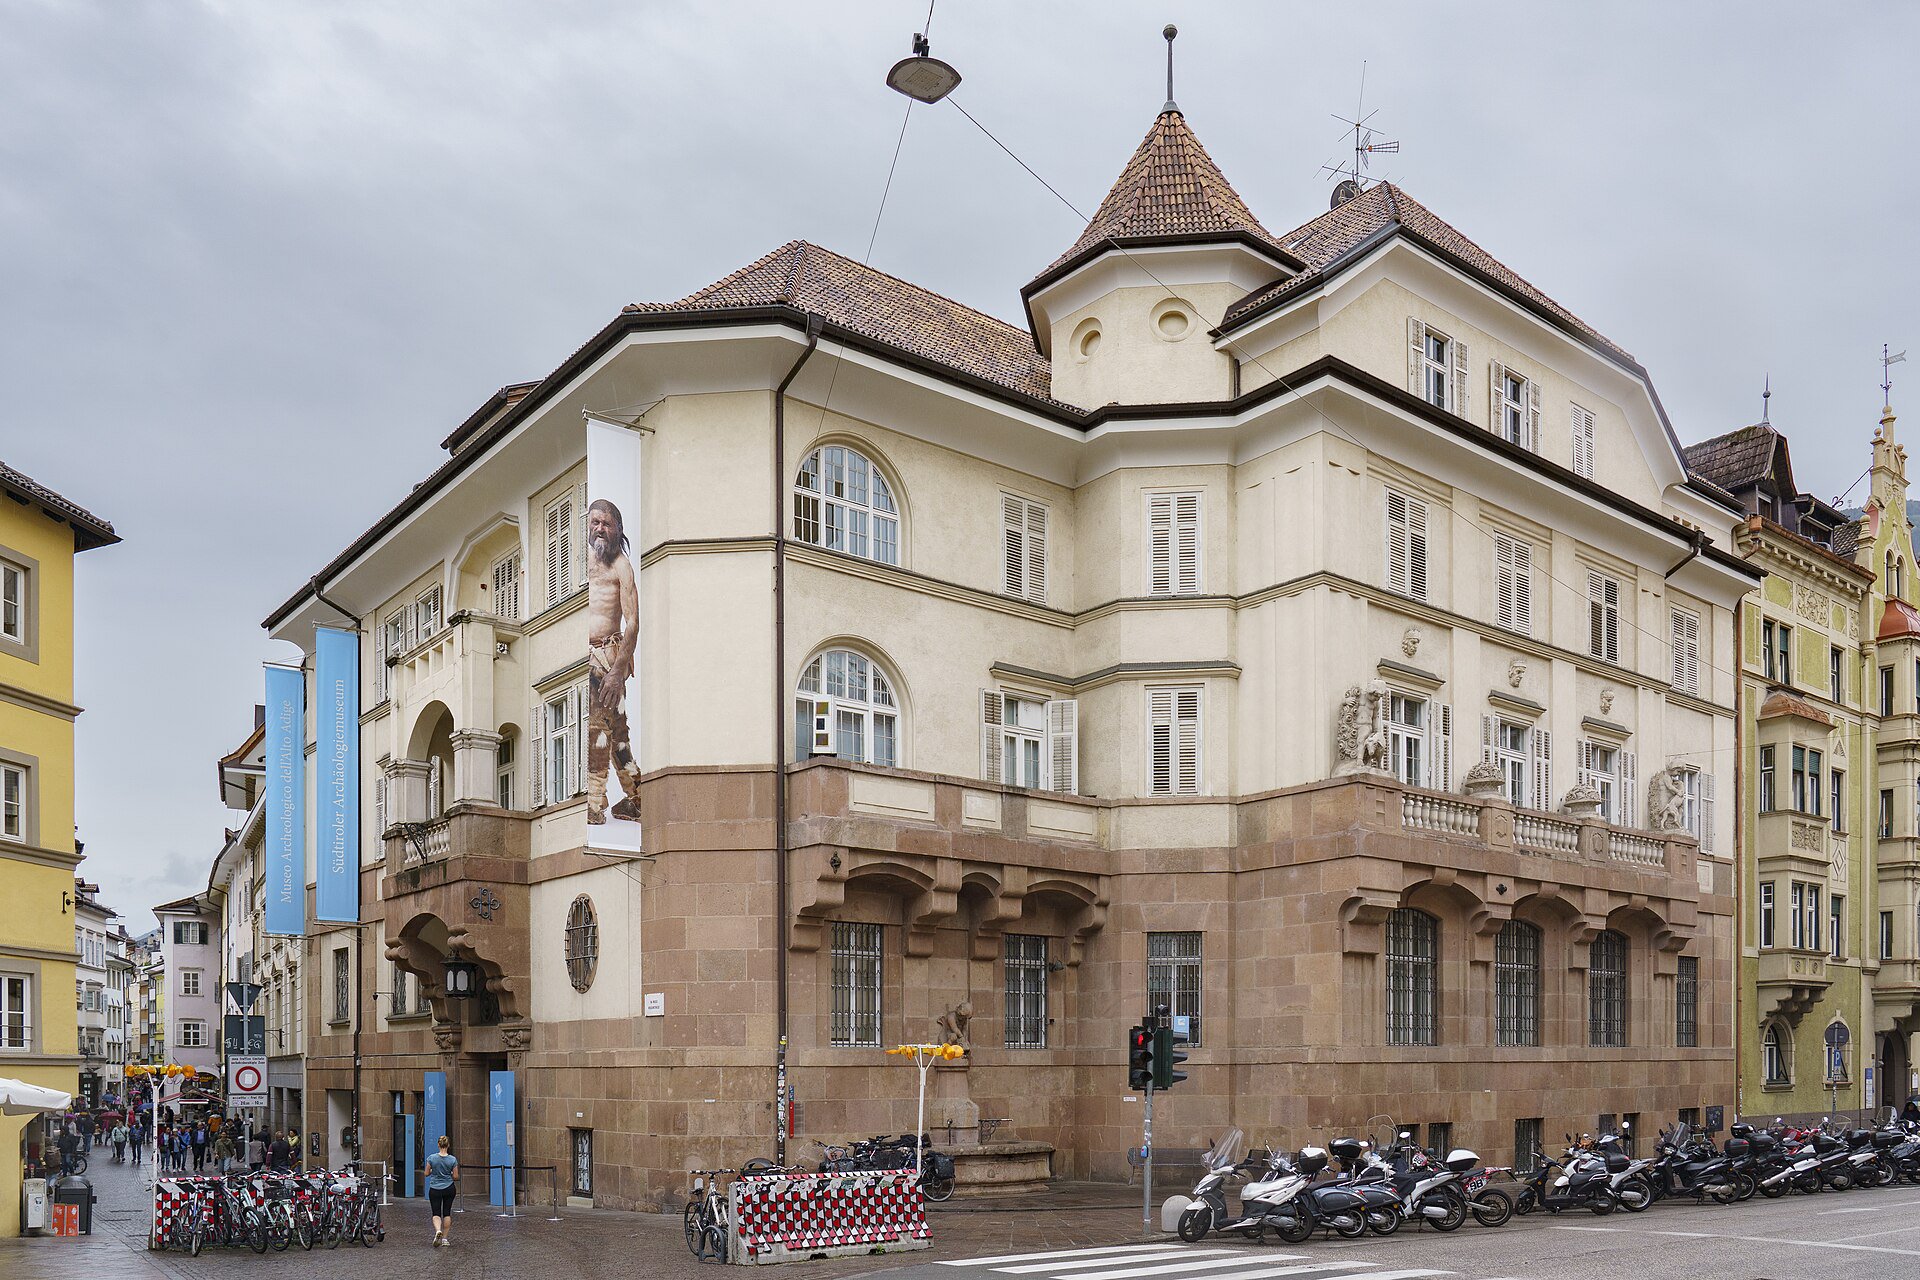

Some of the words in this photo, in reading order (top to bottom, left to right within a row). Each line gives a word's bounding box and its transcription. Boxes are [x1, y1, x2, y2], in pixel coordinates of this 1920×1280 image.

[280, 700, 295, 733] Adige
[331, 679, 349, 809] Archäologiemuseum
[280, 785, 295, 862] Archeologico
[331, 811, 345, 874] Südtiroler
[280, 864, 292, 904] Museo
[1835, 1052, 1840, 1064] P
[1469, 1179, 1483, 1192] 98
